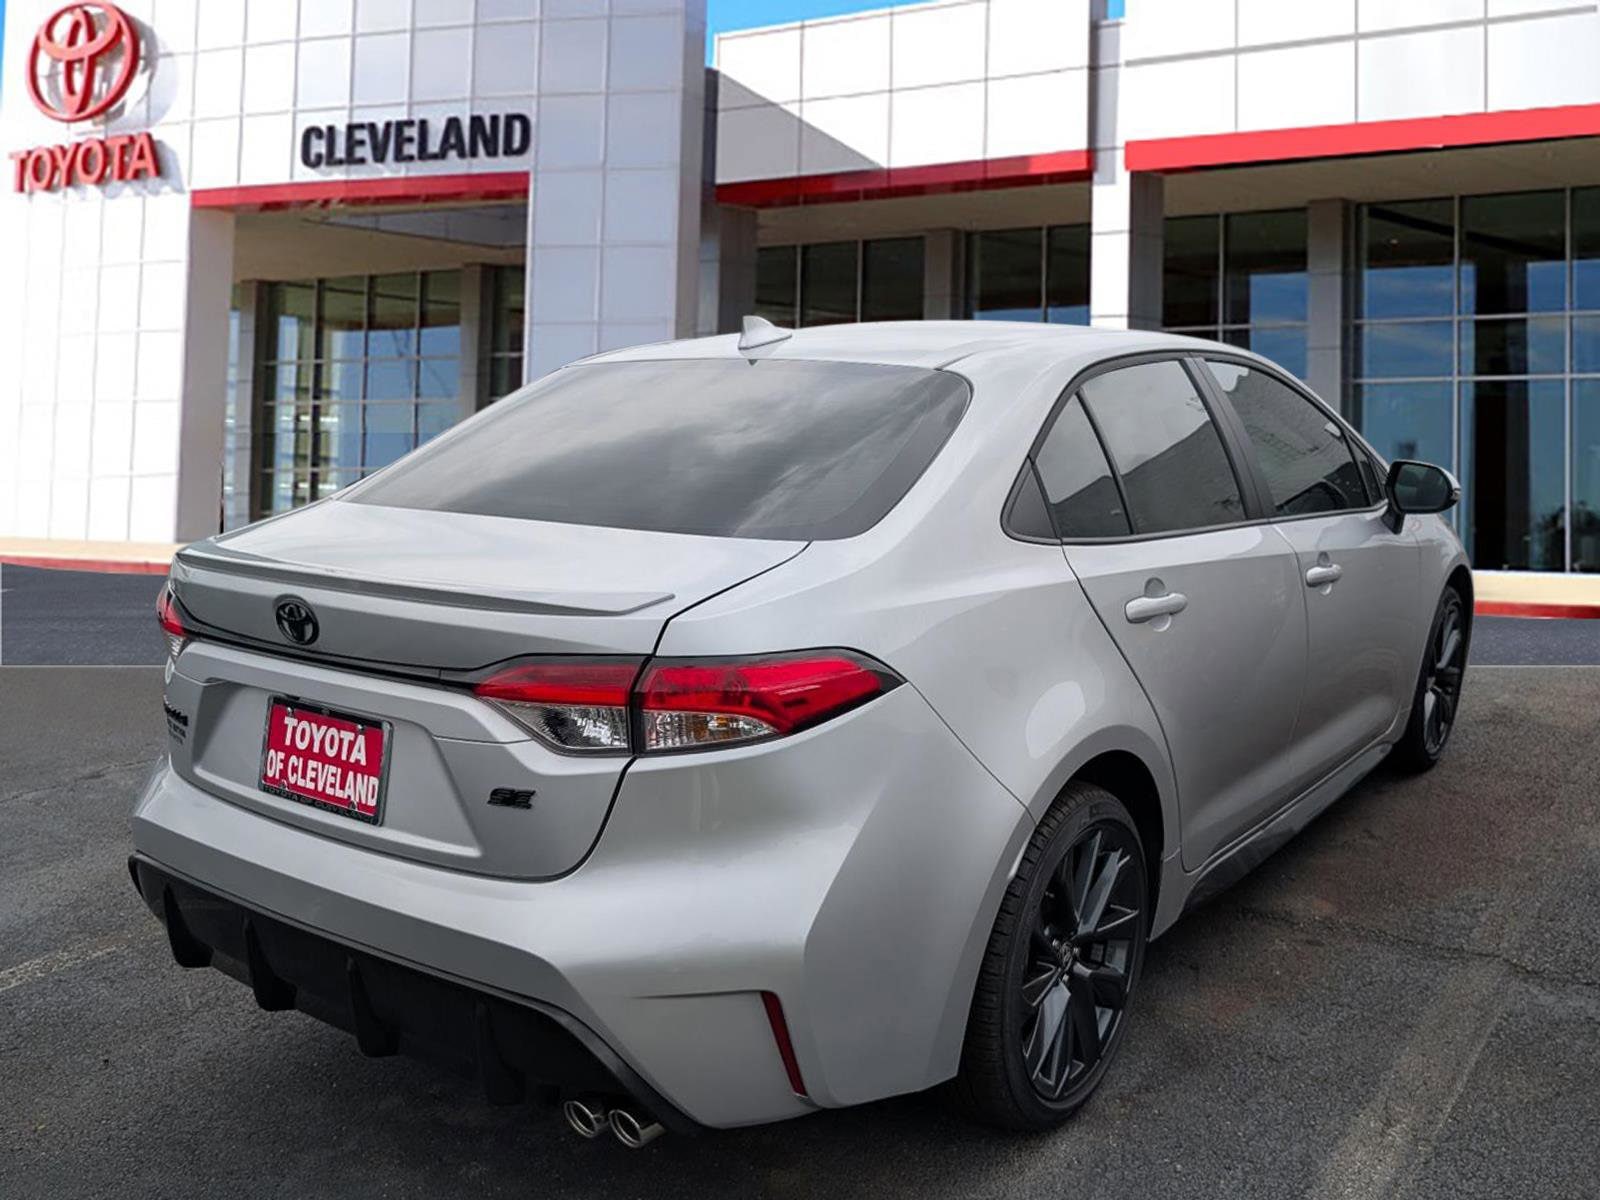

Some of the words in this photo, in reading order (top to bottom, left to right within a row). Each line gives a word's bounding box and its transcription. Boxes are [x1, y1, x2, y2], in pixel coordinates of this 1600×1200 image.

[9, 132, 160, 193] TOYOTA
[301, 114, 531, 168] CLEVELAND
[284, 716, 367, 766] TOYOTA
[266, 749, 285, 779] OF
[287, 757, 379, 806] CLEVELAND
